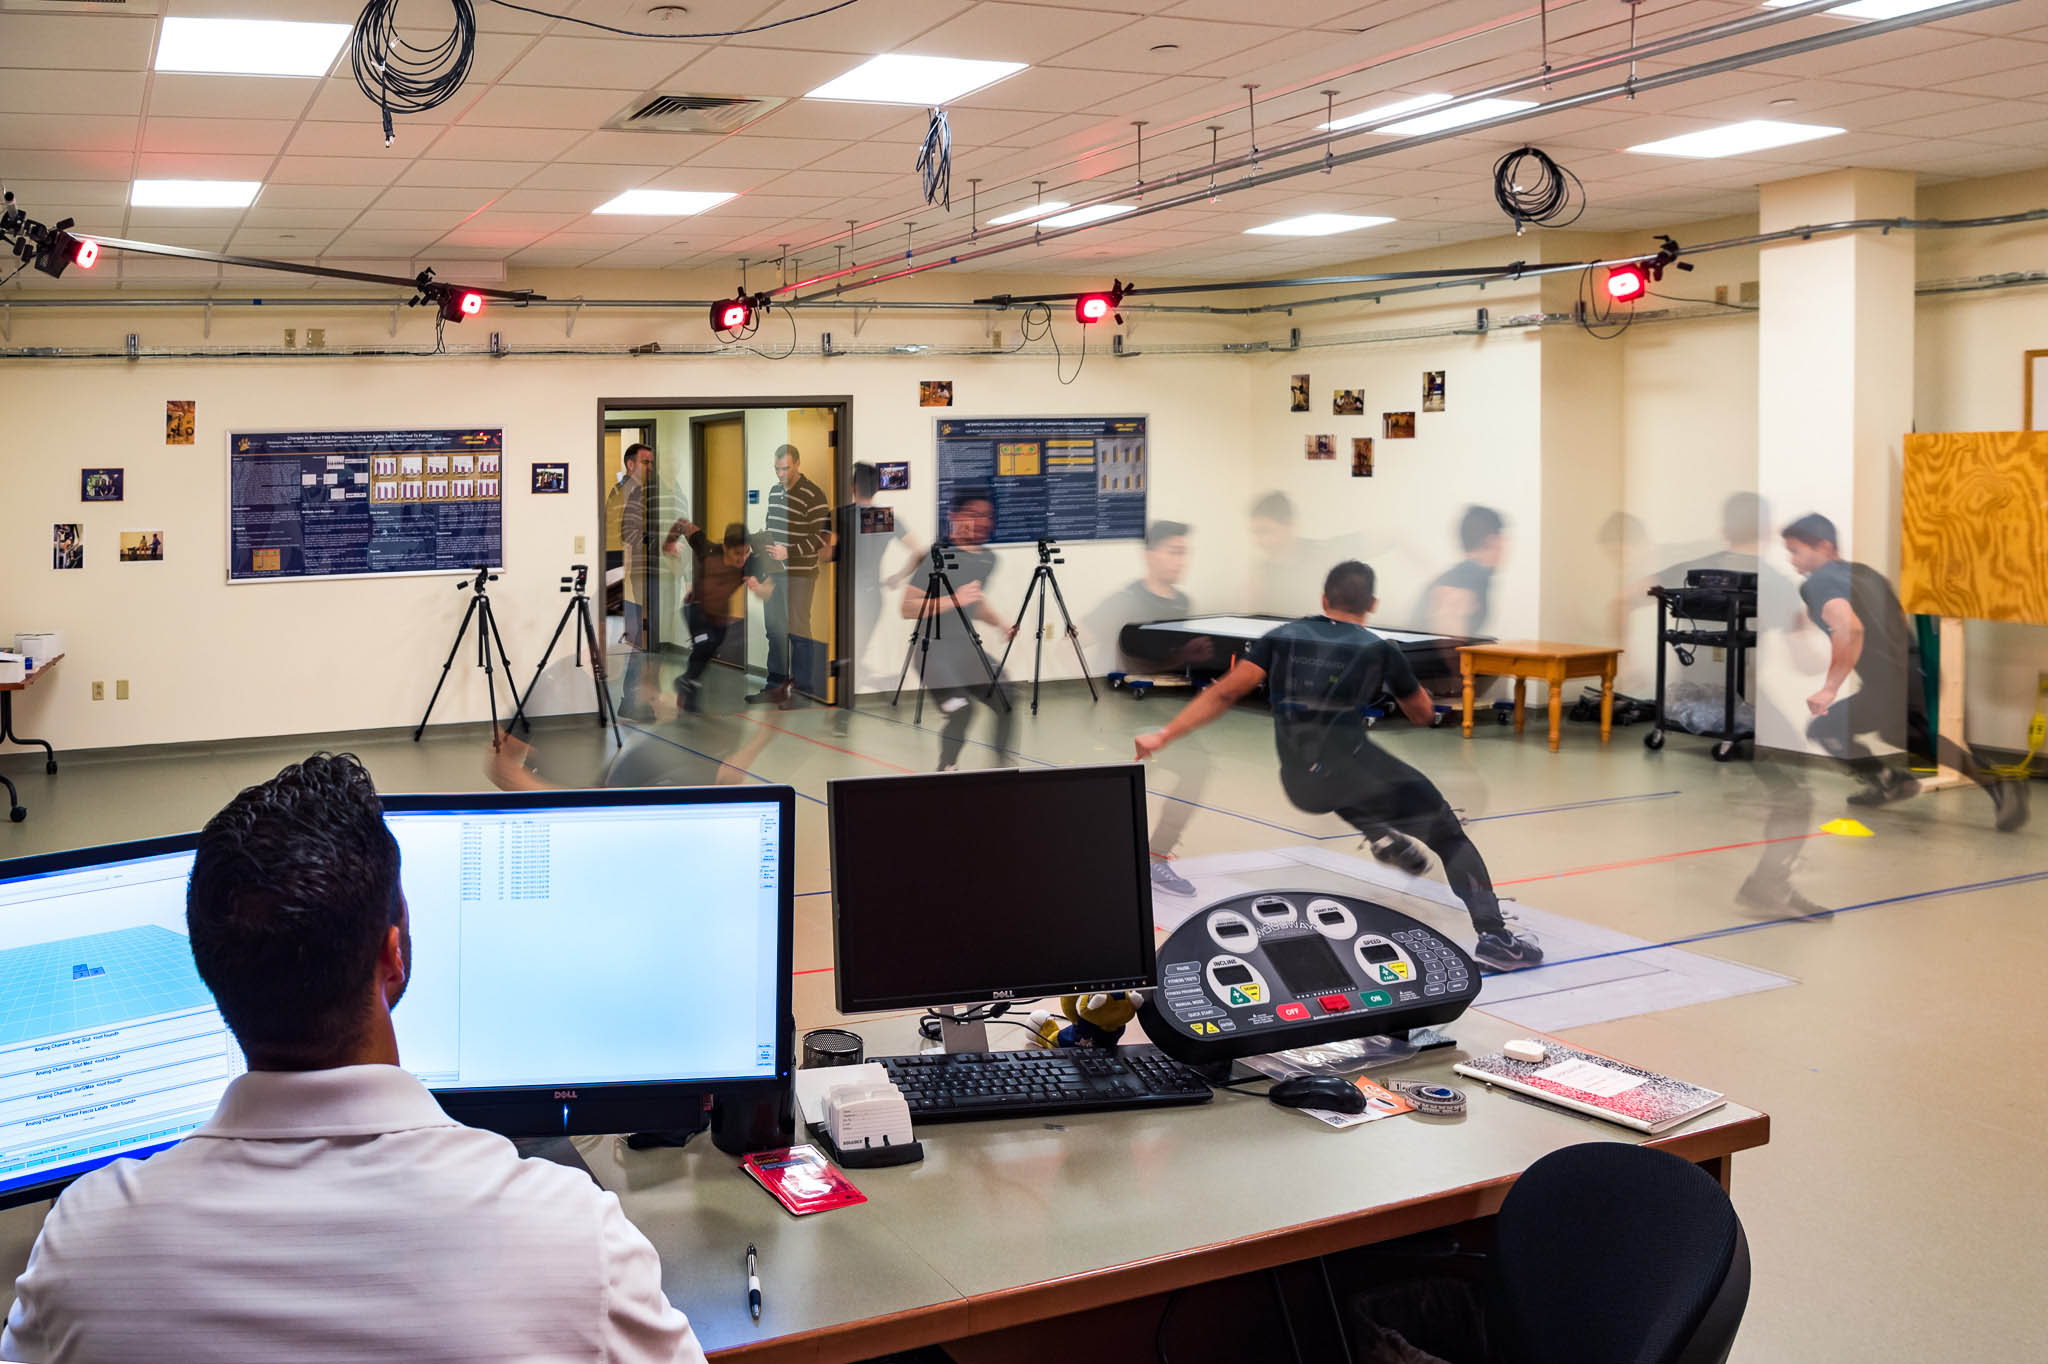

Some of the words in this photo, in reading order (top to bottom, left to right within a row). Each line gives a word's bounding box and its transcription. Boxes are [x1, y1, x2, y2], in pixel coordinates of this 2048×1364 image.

[1213, 959, 1237, 967] INCLINE
[992, 990, 1015, 999] DELL
[1370, 994, 1382, 1002] ON
[1285, 1007, 1299, 1016] OFF
[553, 1089, 577, 1099] DELL
[25, 1119, 42, 1127] Analog
